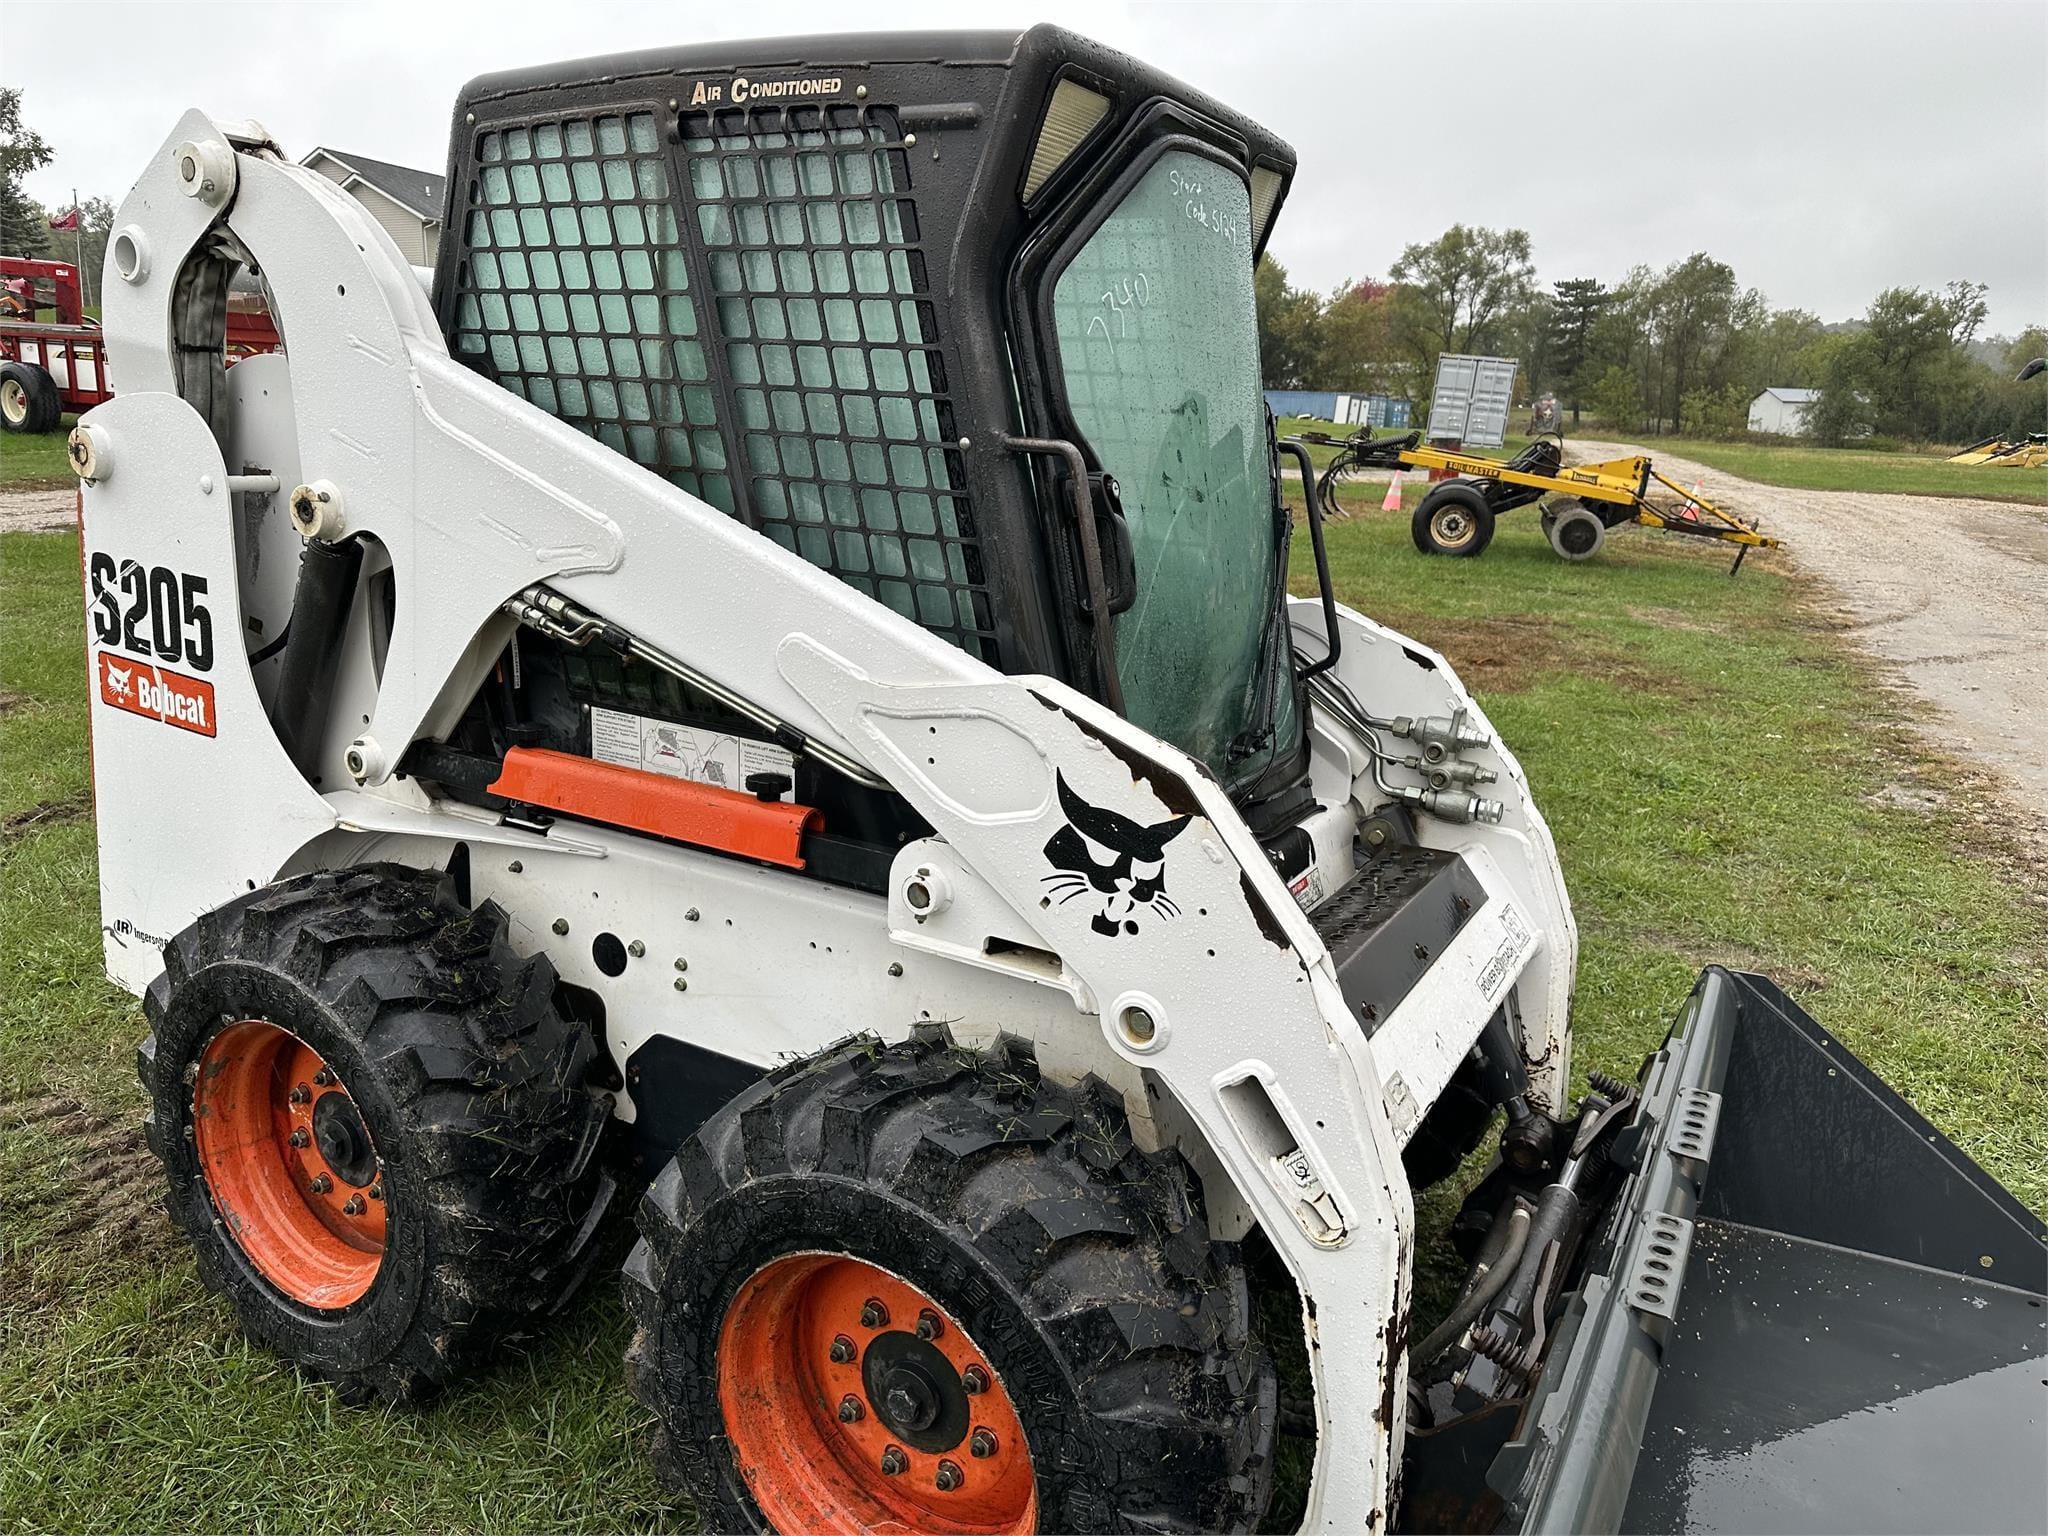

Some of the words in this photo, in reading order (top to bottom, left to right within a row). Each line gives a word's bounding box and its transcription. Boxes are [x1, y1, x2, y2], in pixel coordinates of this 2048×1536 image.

[731, 78, 842, 103] CONDITIONED
[1186, 200, 1208, 227] Code
[91, 552, 214, 672] S205
[137, 676, 207, 728] Bobcat
[922, 1238, 1066, 1417] PREMIUM
